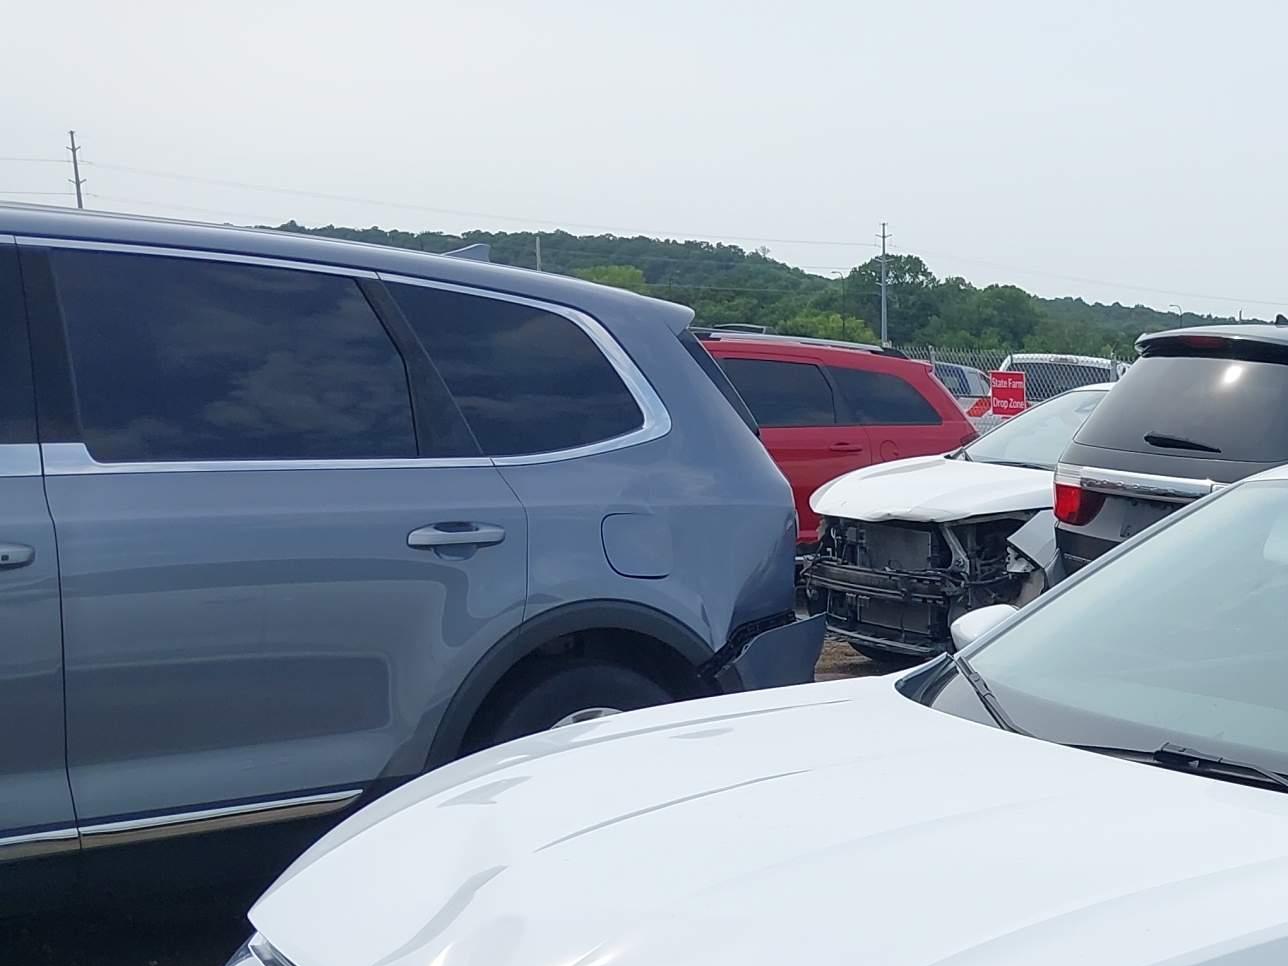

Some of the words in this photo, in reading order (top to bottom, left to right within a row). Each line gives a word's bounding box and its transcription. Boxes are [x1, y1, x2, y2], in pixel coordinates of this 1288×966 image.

[992, 377, 1008, 388] State
[1008, 378, 1024, 389] Farm
[993, 397, 1008, 409] Drop
[1009, 398, 1025, 409] Zone
